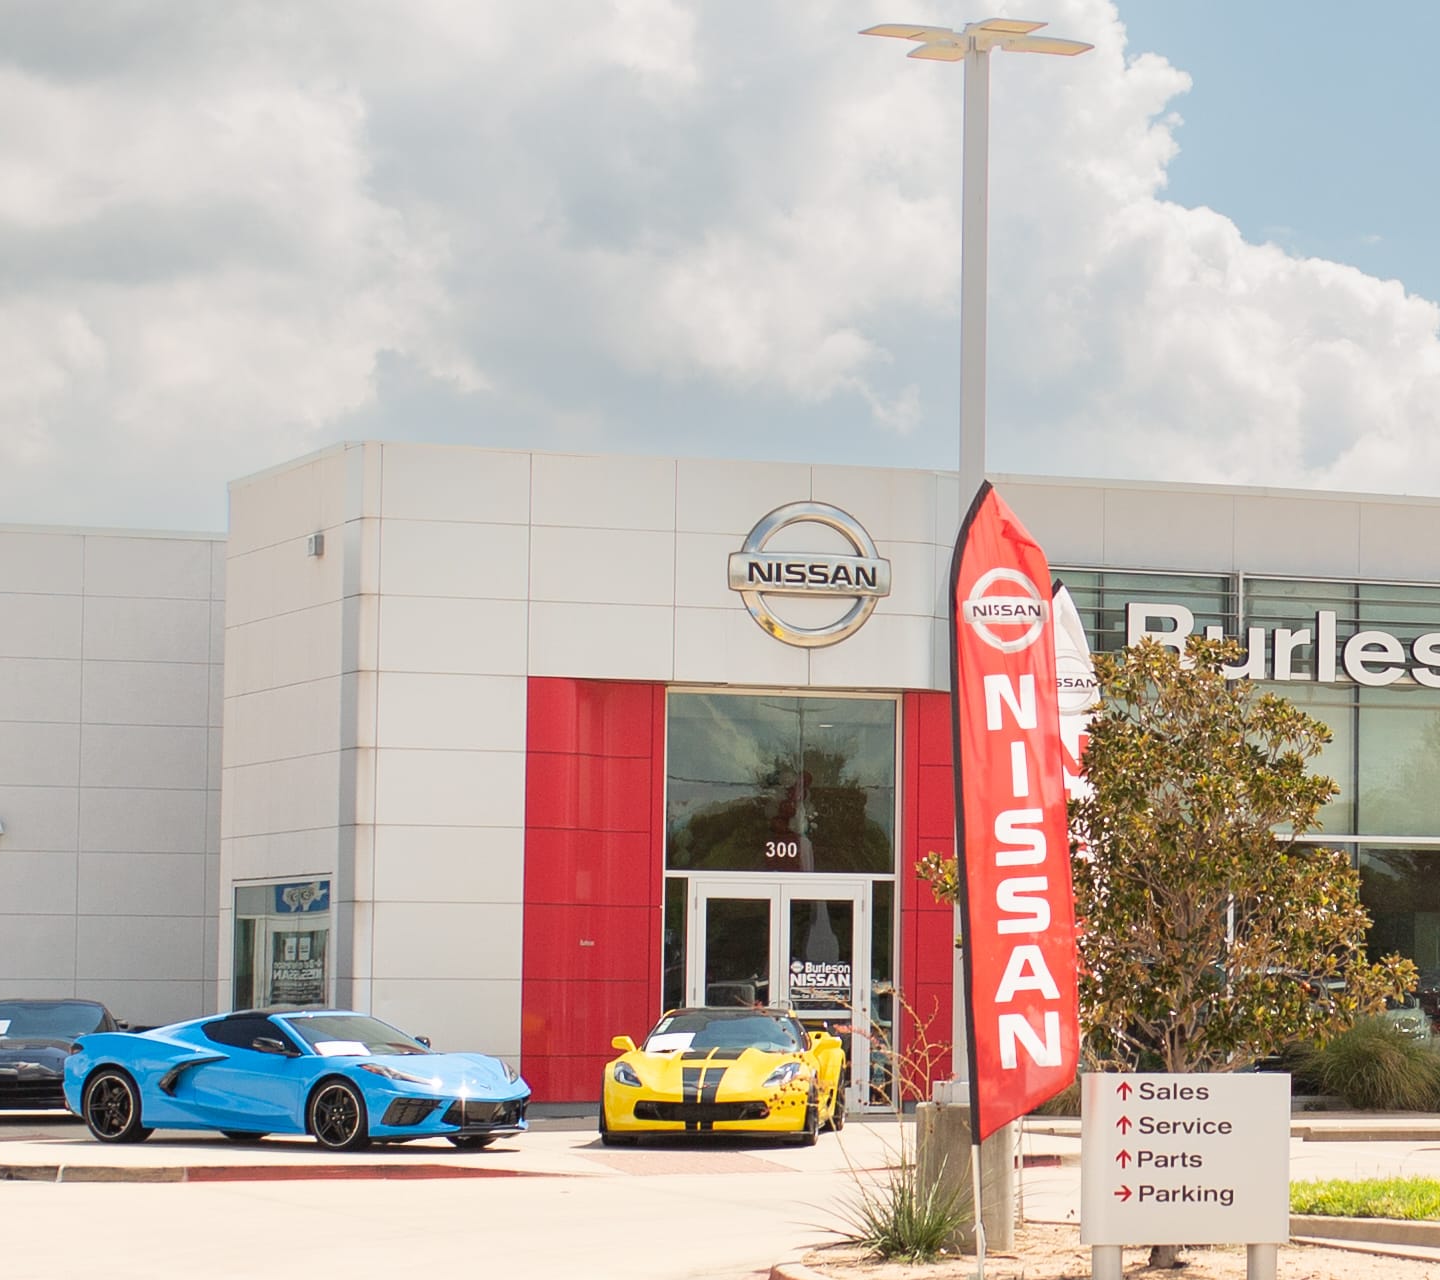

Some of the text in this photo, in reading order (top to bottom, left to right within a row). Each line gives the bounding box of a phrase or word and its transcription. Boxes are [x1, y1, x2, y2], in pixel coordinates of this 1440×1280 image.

[747, 561, 877, 588] NISSAN
[972, 604, 1042, 618] NISSAN
[765, 841, 798, 858] 300
[984, 673, 1063, 1070] NISSAN
[805, 962, 851, 973] Burleson
[790, 973, 851, 987] NISSAN
[1138, 1082, 1210, 1101] Sales
[1138, 1116, 1233, 1135] Service
[1137, 1150, 1203, 1169] Parts
[1138, 1185, 1235, 1207] Parking
